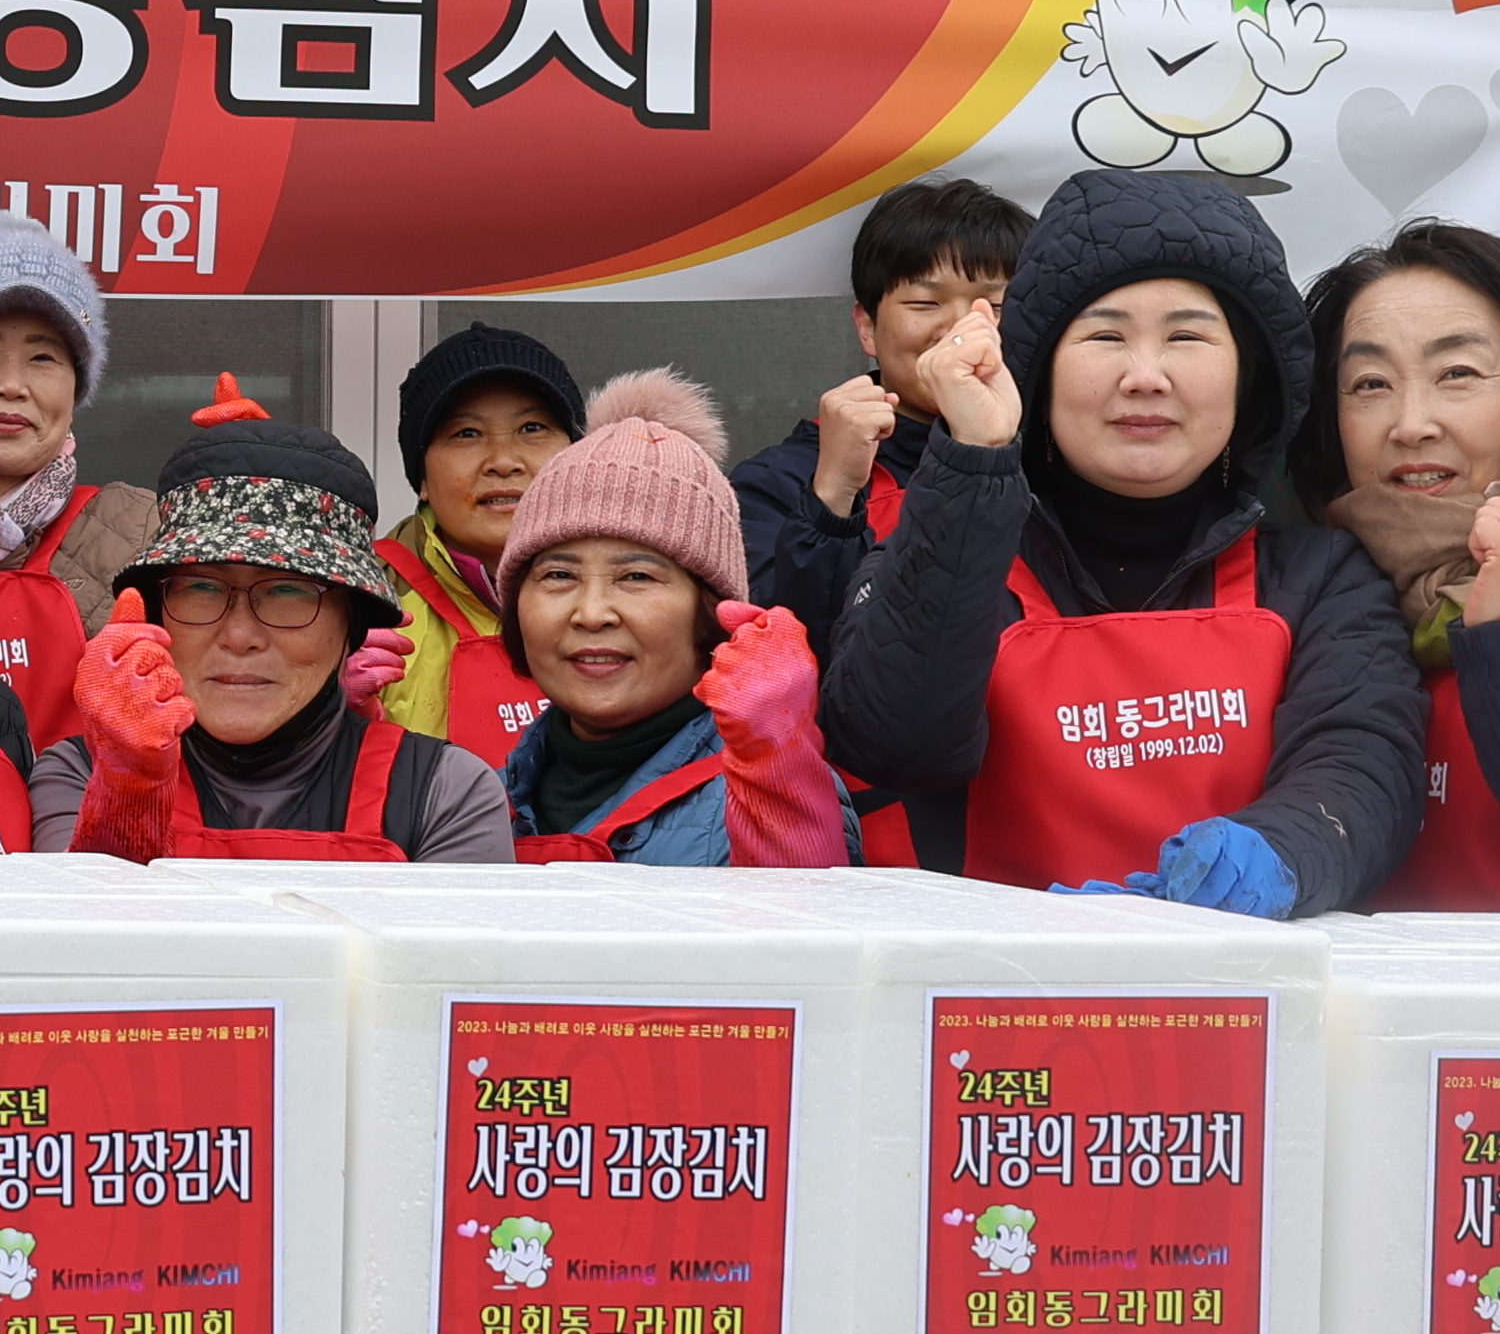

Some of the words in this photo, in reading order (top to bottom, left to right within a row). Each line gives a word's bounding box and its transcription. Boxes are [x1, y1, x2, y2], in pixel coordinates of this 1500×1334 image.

[497, 701, 535, 733] 임회
[1056, 701, 1108, 743] 임회
[1115, 688, 1249, 740] 동그라미회
[1086, 742, 1135, 771] (창립일
[1138, 732, 1225, 761] 1999.12.02)
[476, 1078, 570, 1116] 24주년
[959, 1069, 1050, 1107] 24주년
[467, 1123, 593, 1200] 사랑의
[605, 1125, 767, 1201] 김장김치
[952, 1113, 1074, 1188] 사랑의
[1085, 1112, 1243, 1187] 김장김치
[668, 1259, 750, 1285] KIMCHI
[967, 1289, 1223, 1328] 임회동그라미회
